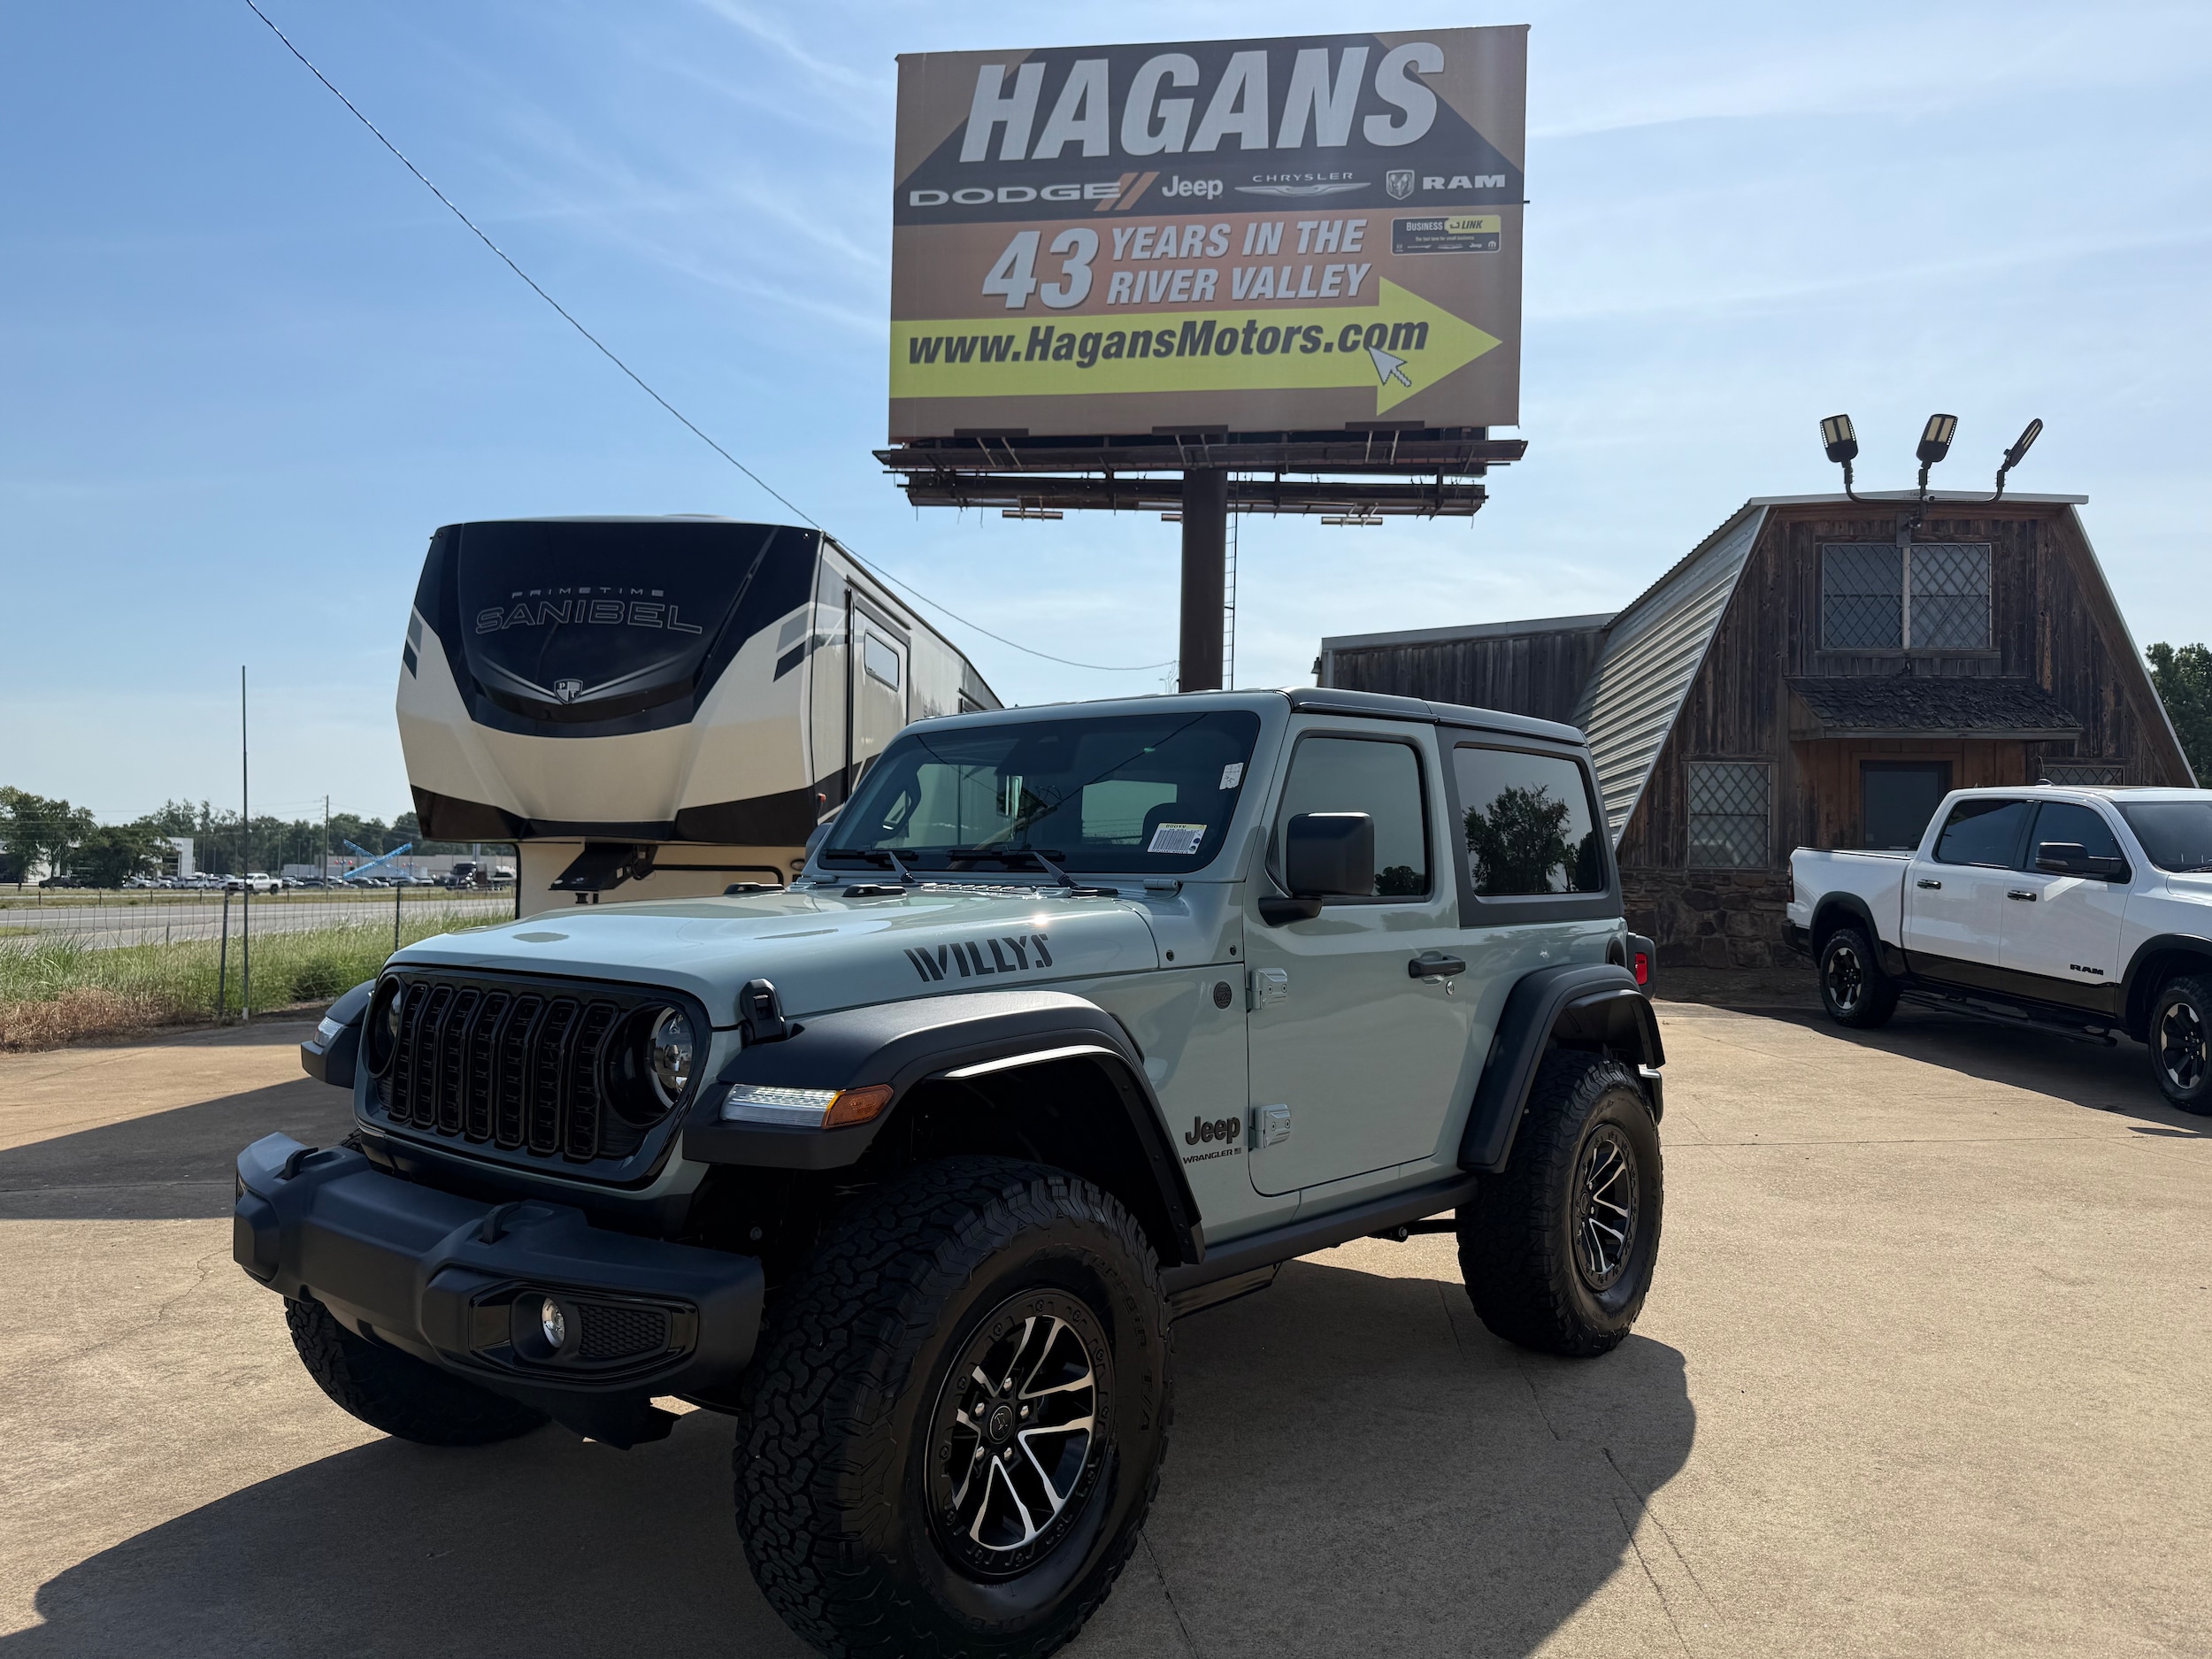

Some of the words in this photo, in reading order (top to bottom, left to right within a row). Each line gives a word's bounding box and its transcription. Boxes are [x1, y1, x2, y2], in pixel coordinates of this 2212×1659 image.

[959, 42, 1445, 163] HAGANS
[1162, 175, 1224, 200] Jeep
[1252, 172, 1353, 182] CHRYSLER
[1422, 174, 1506, 190] RAM
[910, 181, 1121, 206] DODGE
[1111, 223, 1232, 261] YEARS
[1241, 221, 1285, 257] IN
[1295, 219, 1368, 255] THE
[1406, 221, 1443, 231] BUSINESS
[1461, 220, 1483, 229] LINK
[981, 227, 1101, 311] 43
[1107, 268, 1219, 306] RIVER
[1231, 263, 1372, 302] VALLEY
[909, 319, 1429, 368] www.HagansMotors.com
[475, 599, 703, 634] SANIBEL
[902, 933, 1053, 982] WILLYS
[2070, 964, 2103, 976] RAM
[1185, 1116, 1240, 1146] Jeep
[1182, 1148, 1233, 1164] WRANGLER
